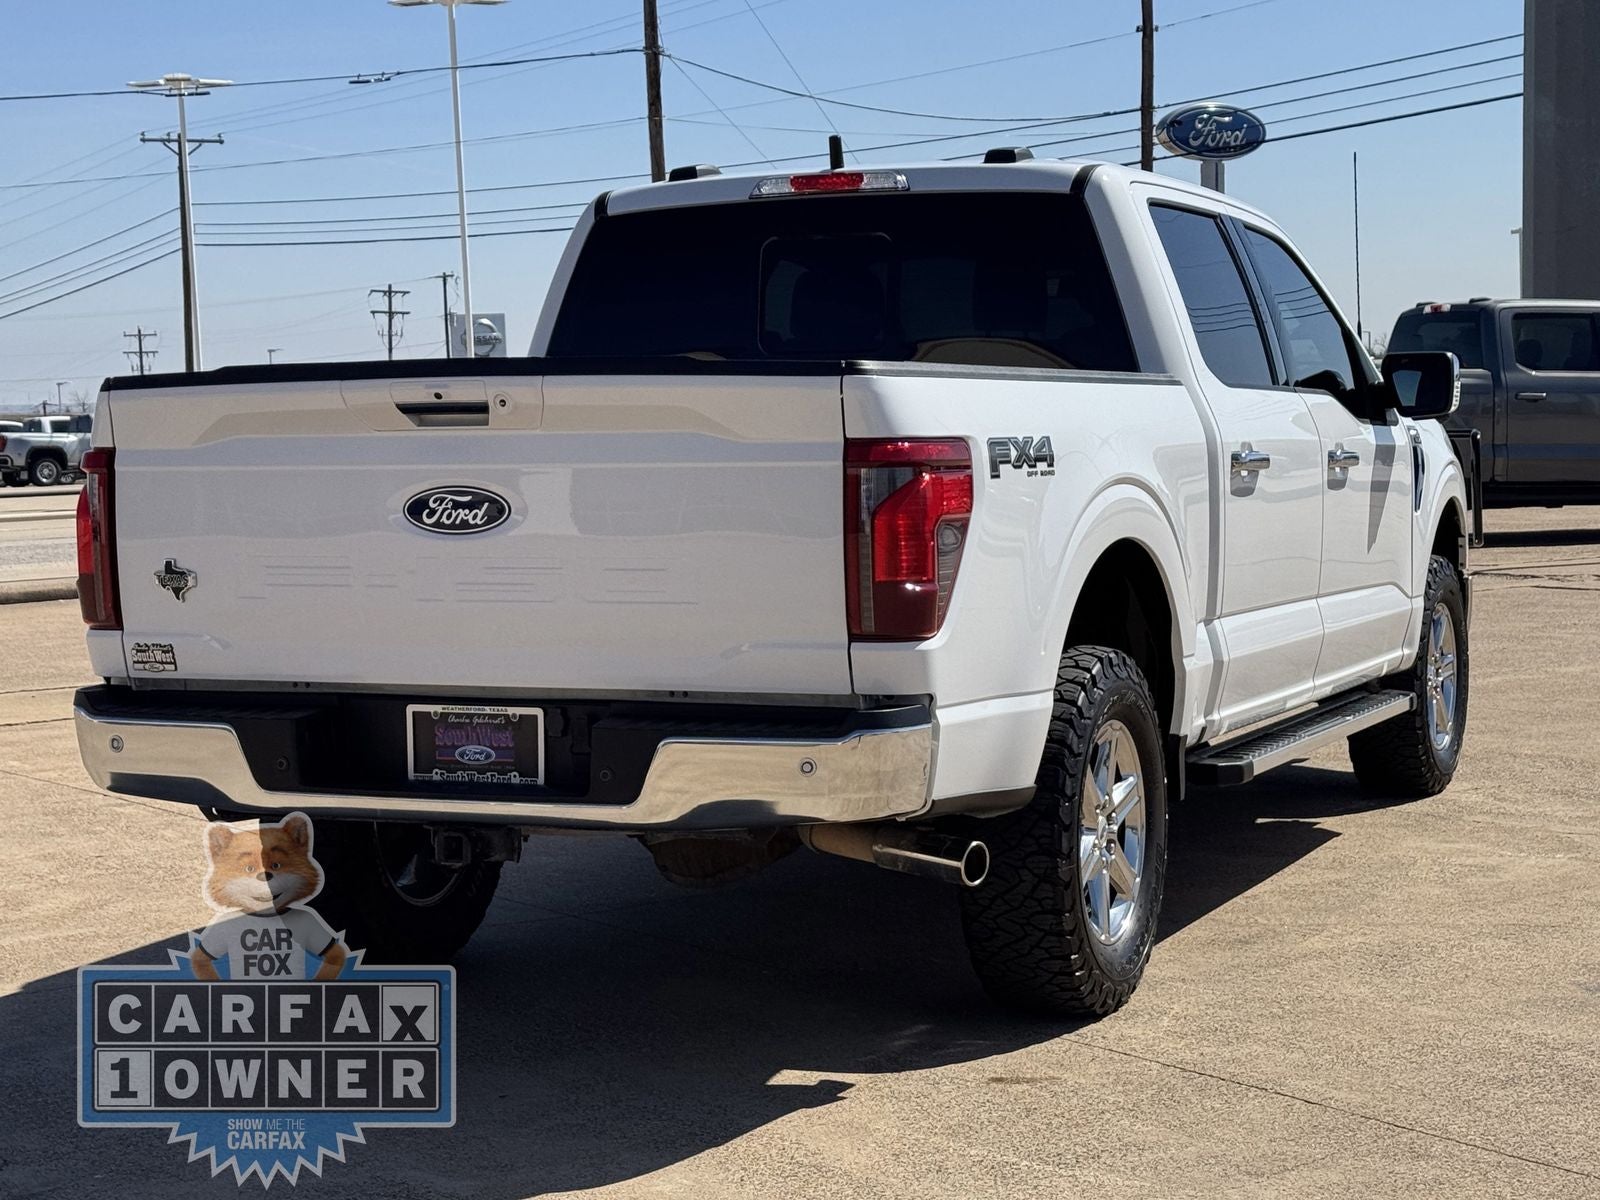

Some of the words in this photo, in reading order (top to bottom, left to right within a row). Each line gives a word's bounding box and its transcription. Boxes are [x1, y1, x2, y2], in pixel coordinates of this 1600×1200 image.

[1189, 113, 1248, 147] Ford
[986, 436, 1054, 479] FX4
[1040, 469, 1055, 477] ROAD
[422, 494, 490, 525] Ford
[154, 571, 189, 587] TEXAS
[463, 749, 486, 761] Ford
